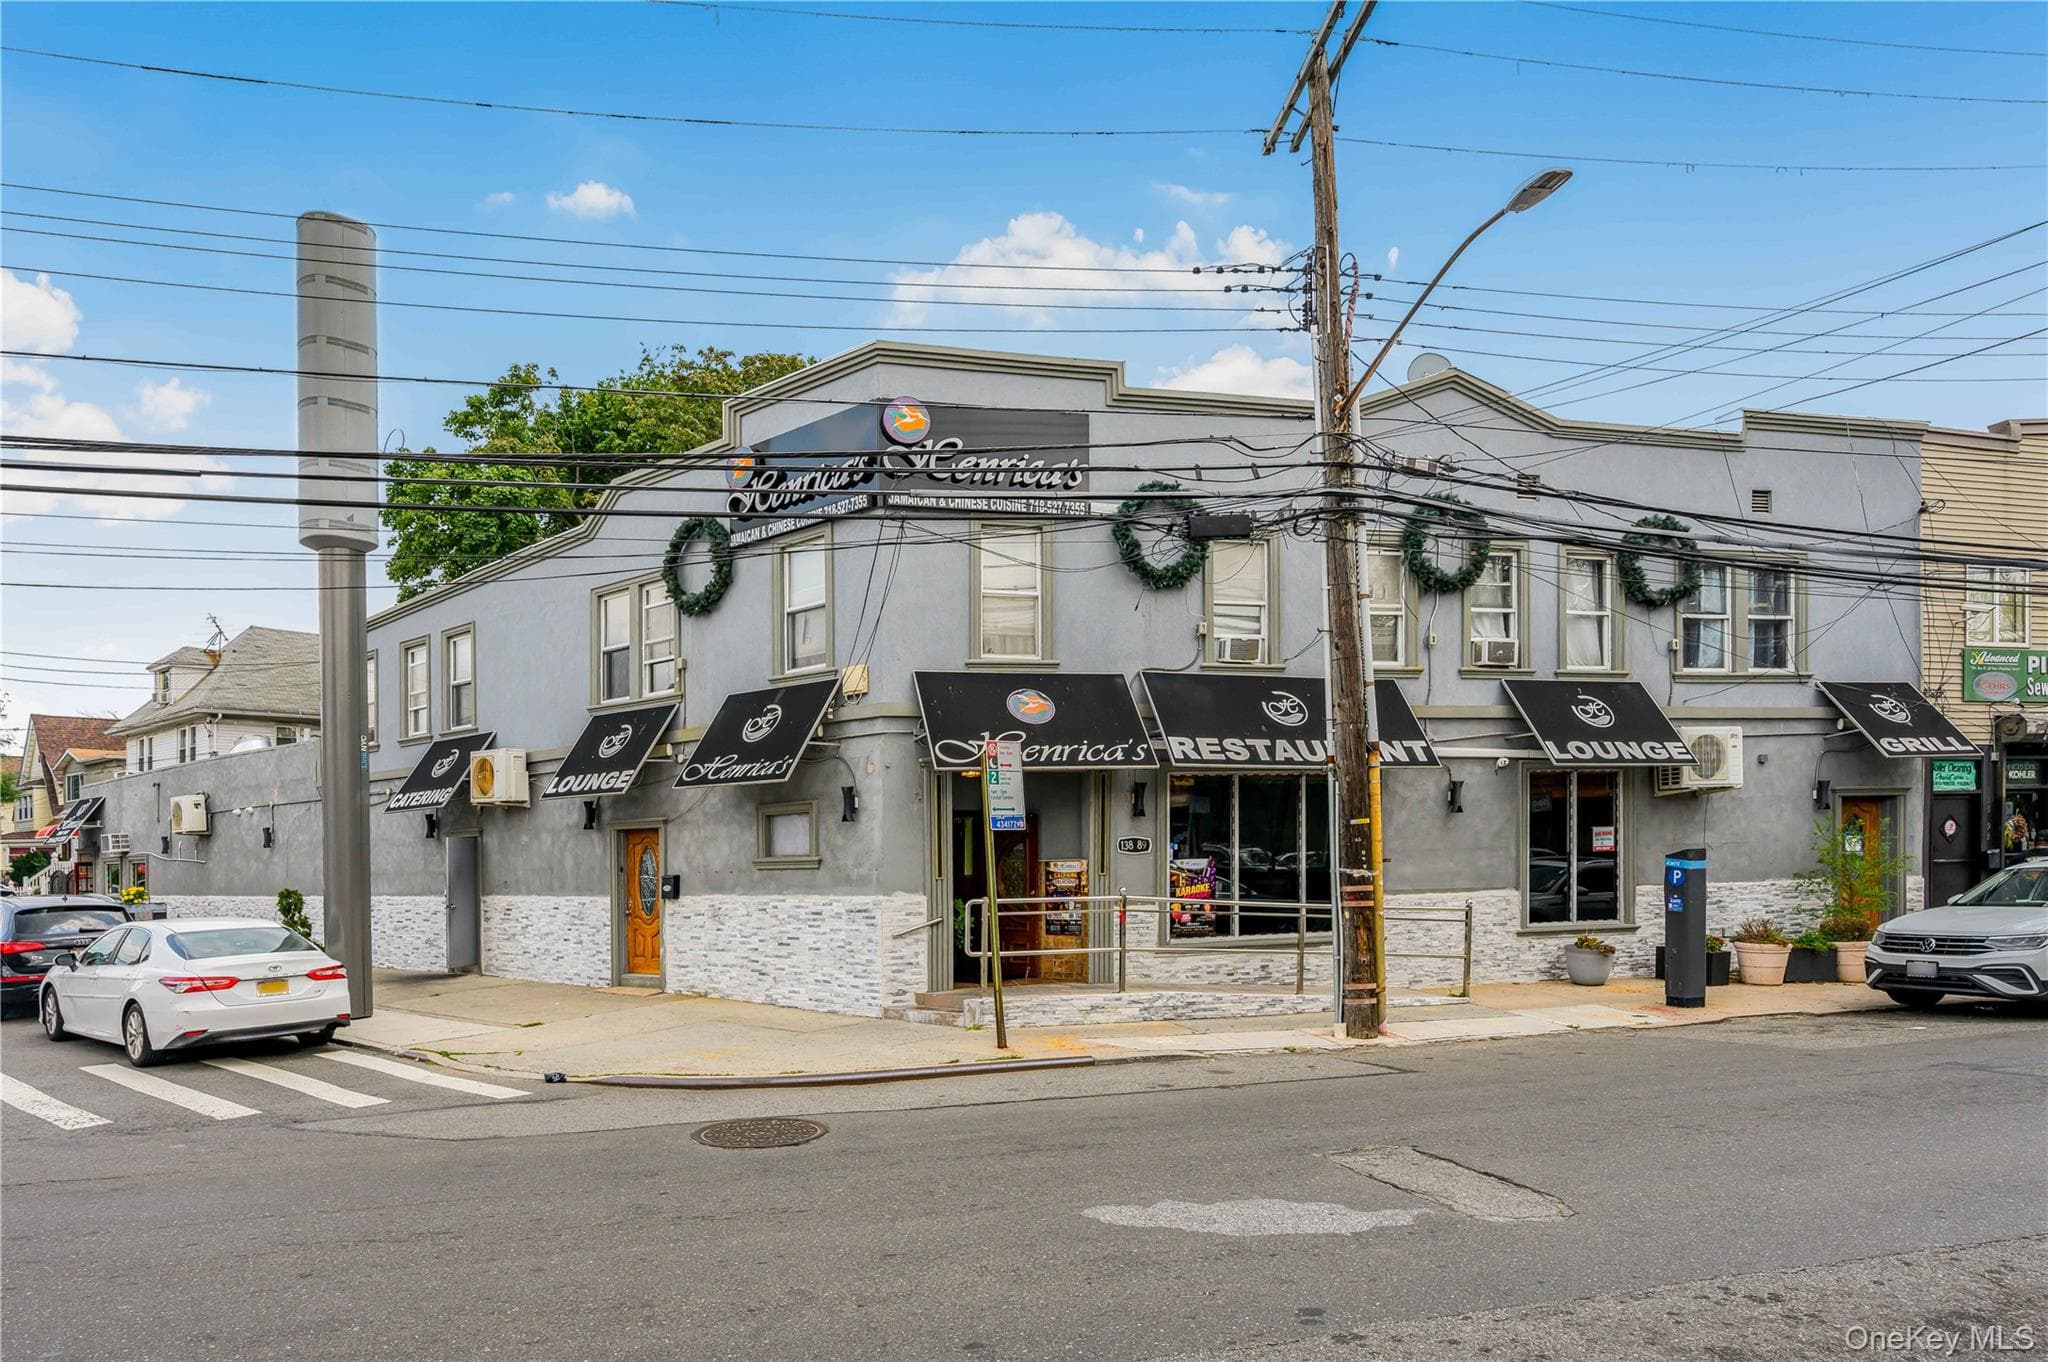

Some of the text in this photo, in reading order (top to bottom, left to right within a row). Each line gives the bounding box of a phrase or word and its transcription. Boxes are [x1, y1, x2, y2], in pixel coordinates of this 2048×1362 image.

[883, 438, 1089, 487] Henrica's
[727, 456, 868, 519] Henrica's
[768, 517, 796, 535] CHINESE
[824, 495, 868, 516] 718-527-7355
[889, 495, 1085, 515] JAMAICAN & CHINESE CUISINE 718-527-7355
[1970, 651, 2020, 666] Advanced
[935, 731, 1148, 763] Henrica's
[1168, 737, 1428, 762] RESTAUNT
[1545, 741, 1693, 760] LOUNGE
[1880, 737, 1974, 752] GRILL
[682, 754, 793, 781] Henrica's
[991, 772, 997, 783] 2
[2008, 770, 2036, 779] KOHLER
[546, 769, 635, 794] LOUNGE
[390, 787, 452, 808] CATERING
[1176, 883, 1211, 897] KARAOKE
